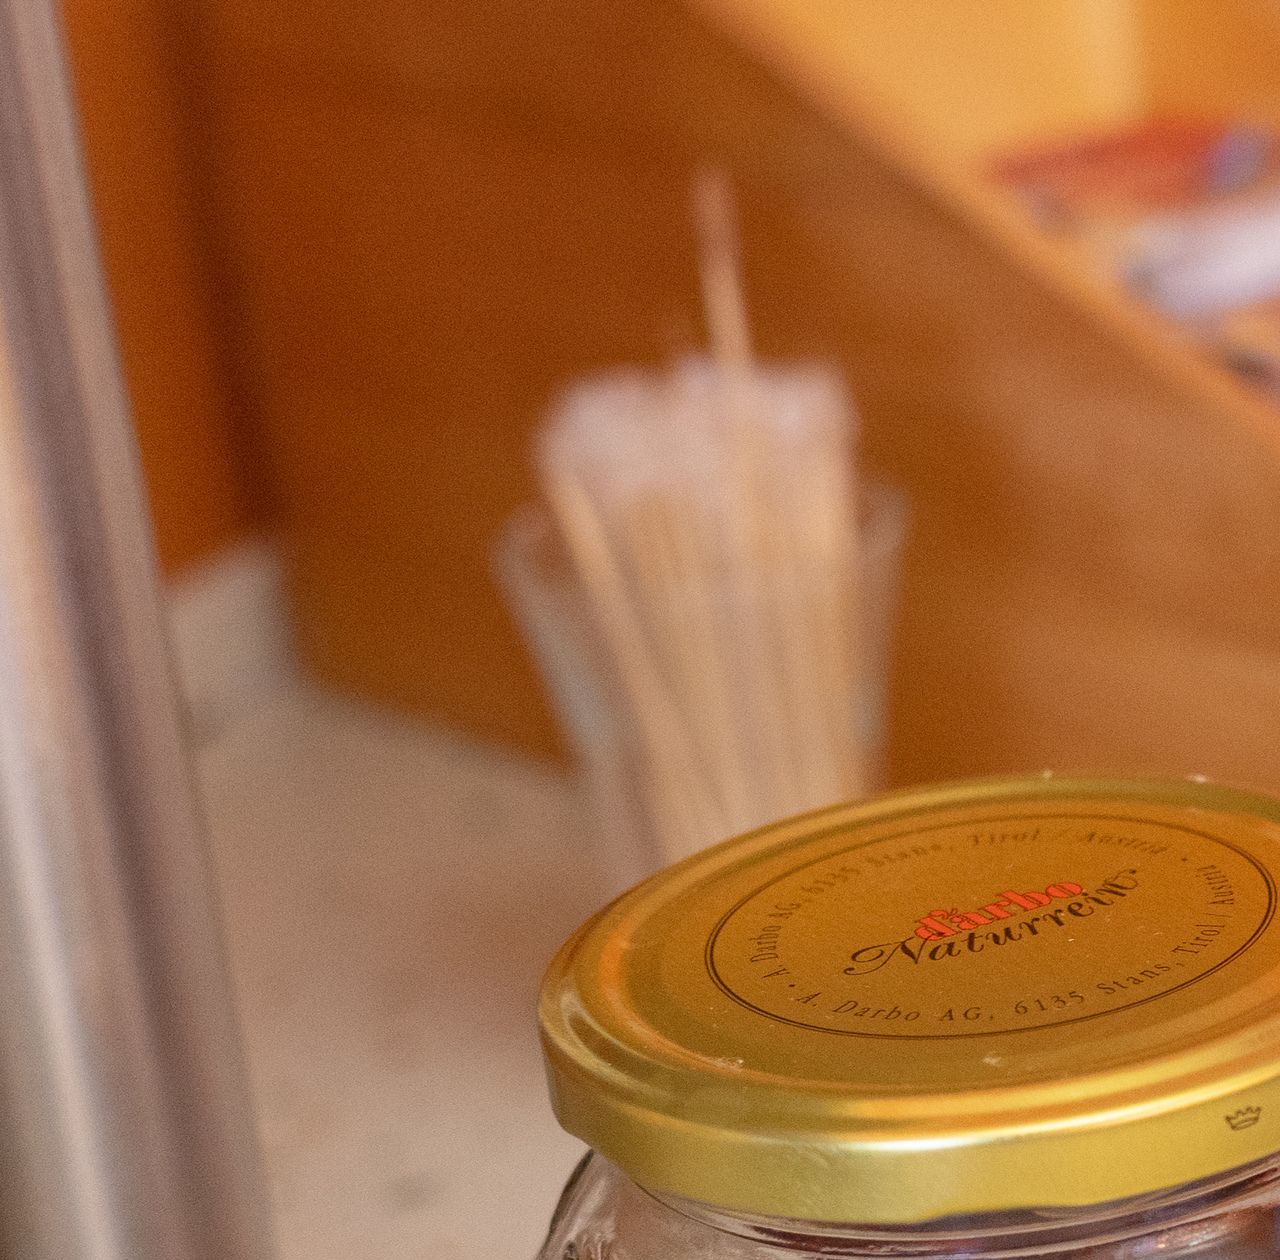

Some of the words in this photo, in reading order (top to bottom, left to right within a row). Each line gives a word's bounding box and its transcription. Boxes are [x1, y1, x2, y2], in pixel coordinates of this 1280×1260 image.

[831, 1000, 921, 1022] Darbo
[1013, 990, 1085, 1016] 6135
[1170, 923, 1226, 955] Tirol
